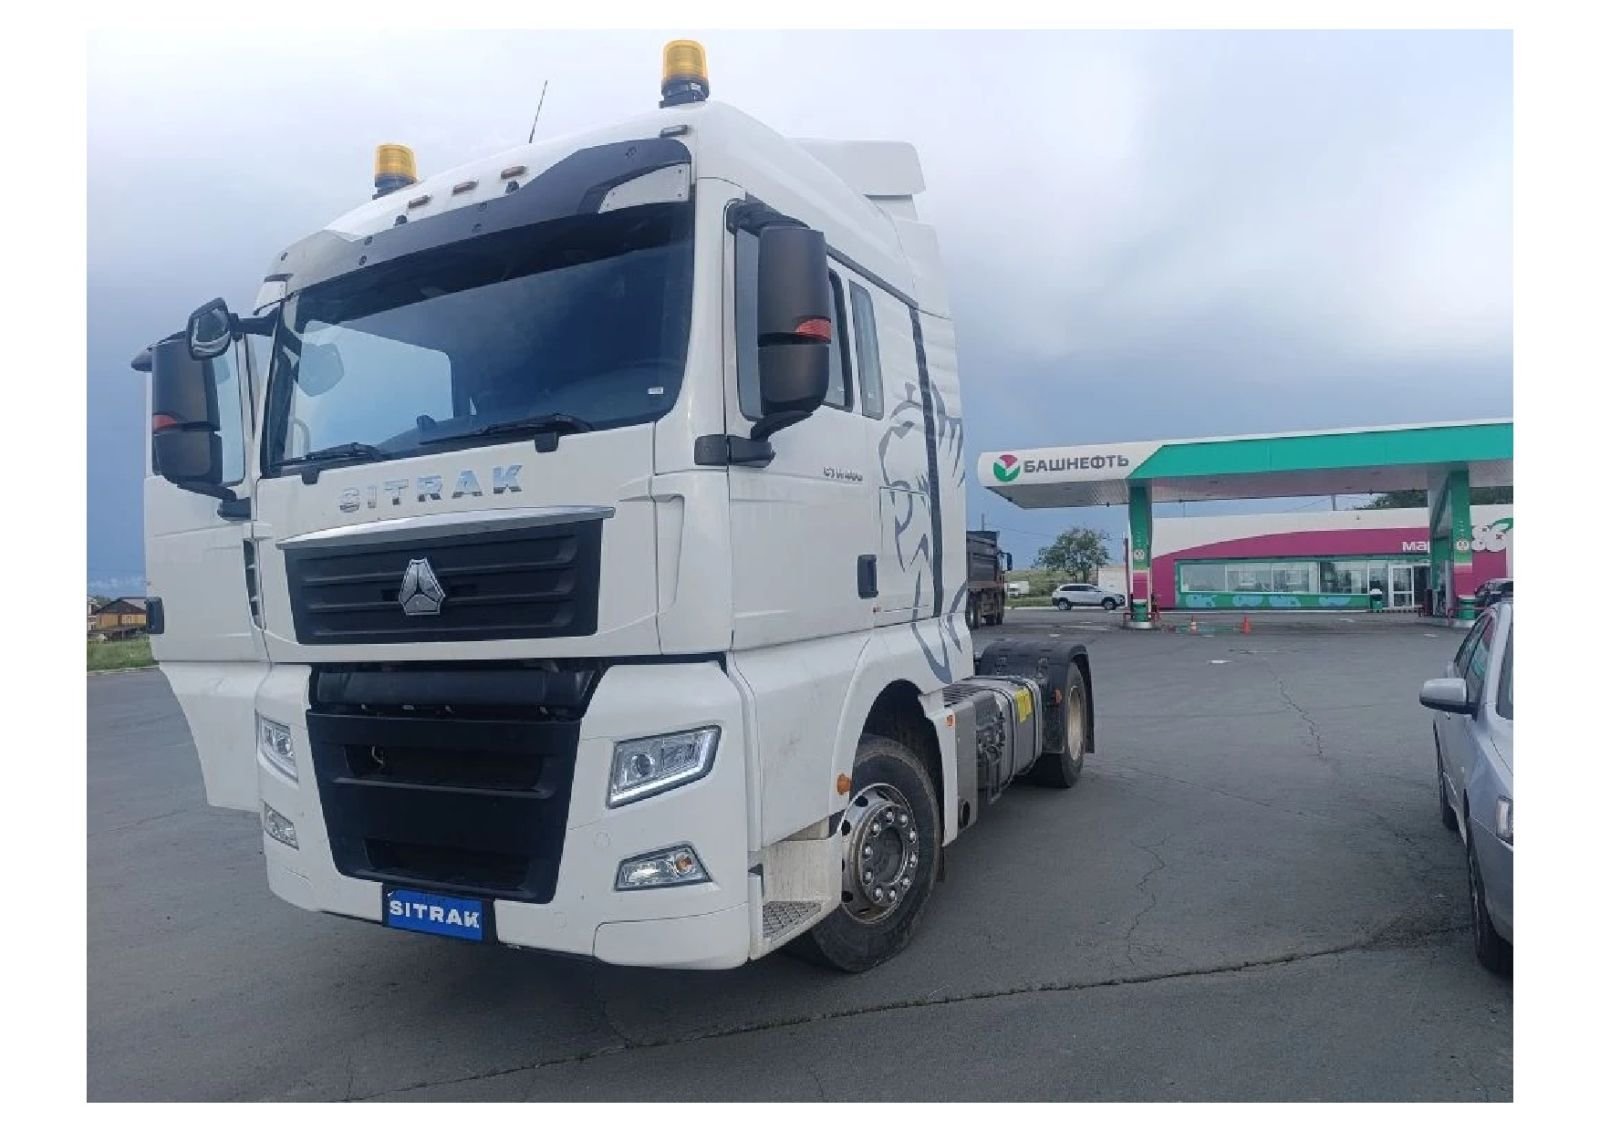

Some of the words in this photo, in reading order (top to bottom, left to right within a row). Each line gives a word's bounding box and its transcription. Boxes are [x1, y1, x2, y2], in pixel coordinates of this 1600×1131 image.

[1023, 454, 1129, 473] БАШНЕФТЬ
[339, 464, 523, 513] SITRAK
[389, 900, 480, 929] SITRAK
